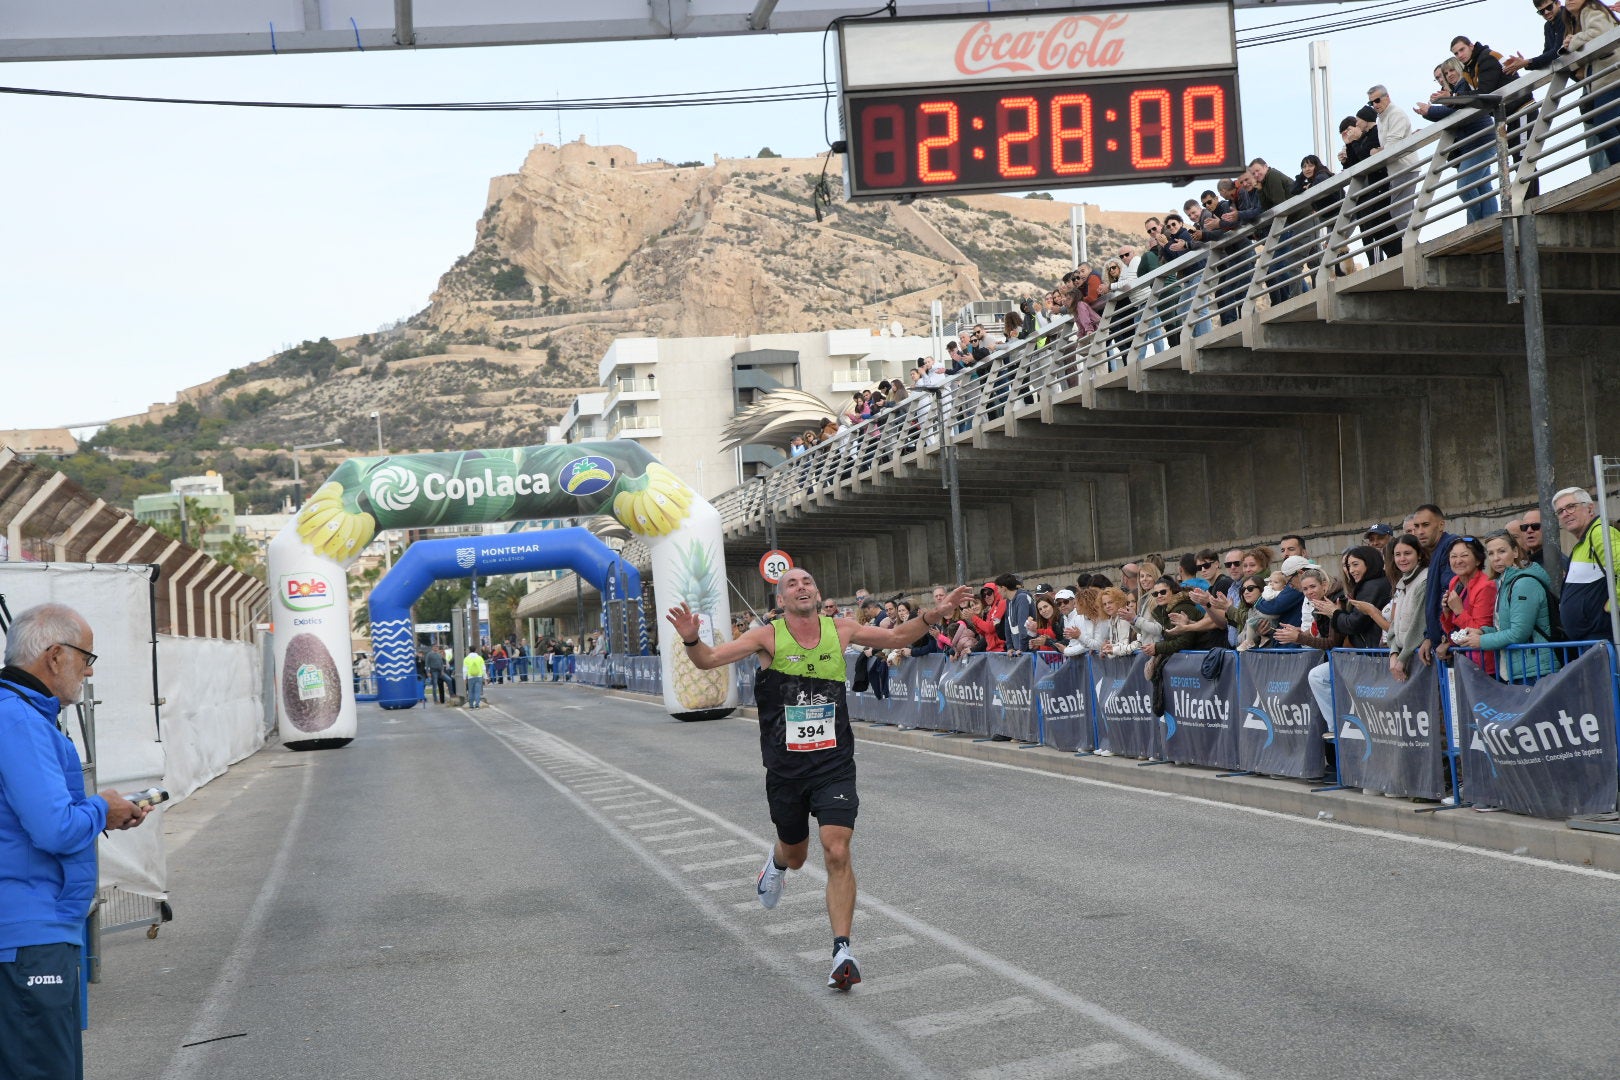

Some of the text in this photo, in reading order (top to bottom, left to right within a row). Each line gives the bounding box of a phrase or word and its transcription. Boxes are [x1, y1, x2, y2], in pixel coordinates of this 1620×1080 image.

[954, 13, 1130, 75] Coca-Cola
[917, 85, 1226, 184] 2:28:08
[423, 468, 551, 506] Coplaca
[481, 544, 540, 557] MONTEMAR
[767, 561, 786, 573] 30
[287, 578, 327, 596] Dole
[293, 617, 323, 627] Exotics
[1170, 676, 1201, 689] DEPORTES
[1104, 690, 1152, 715] Alicante
[1173, 689, 1230, 721] Alicante
[1361, 701, 1430, 737] Alicante
[797, 724, 825, 739] 394
